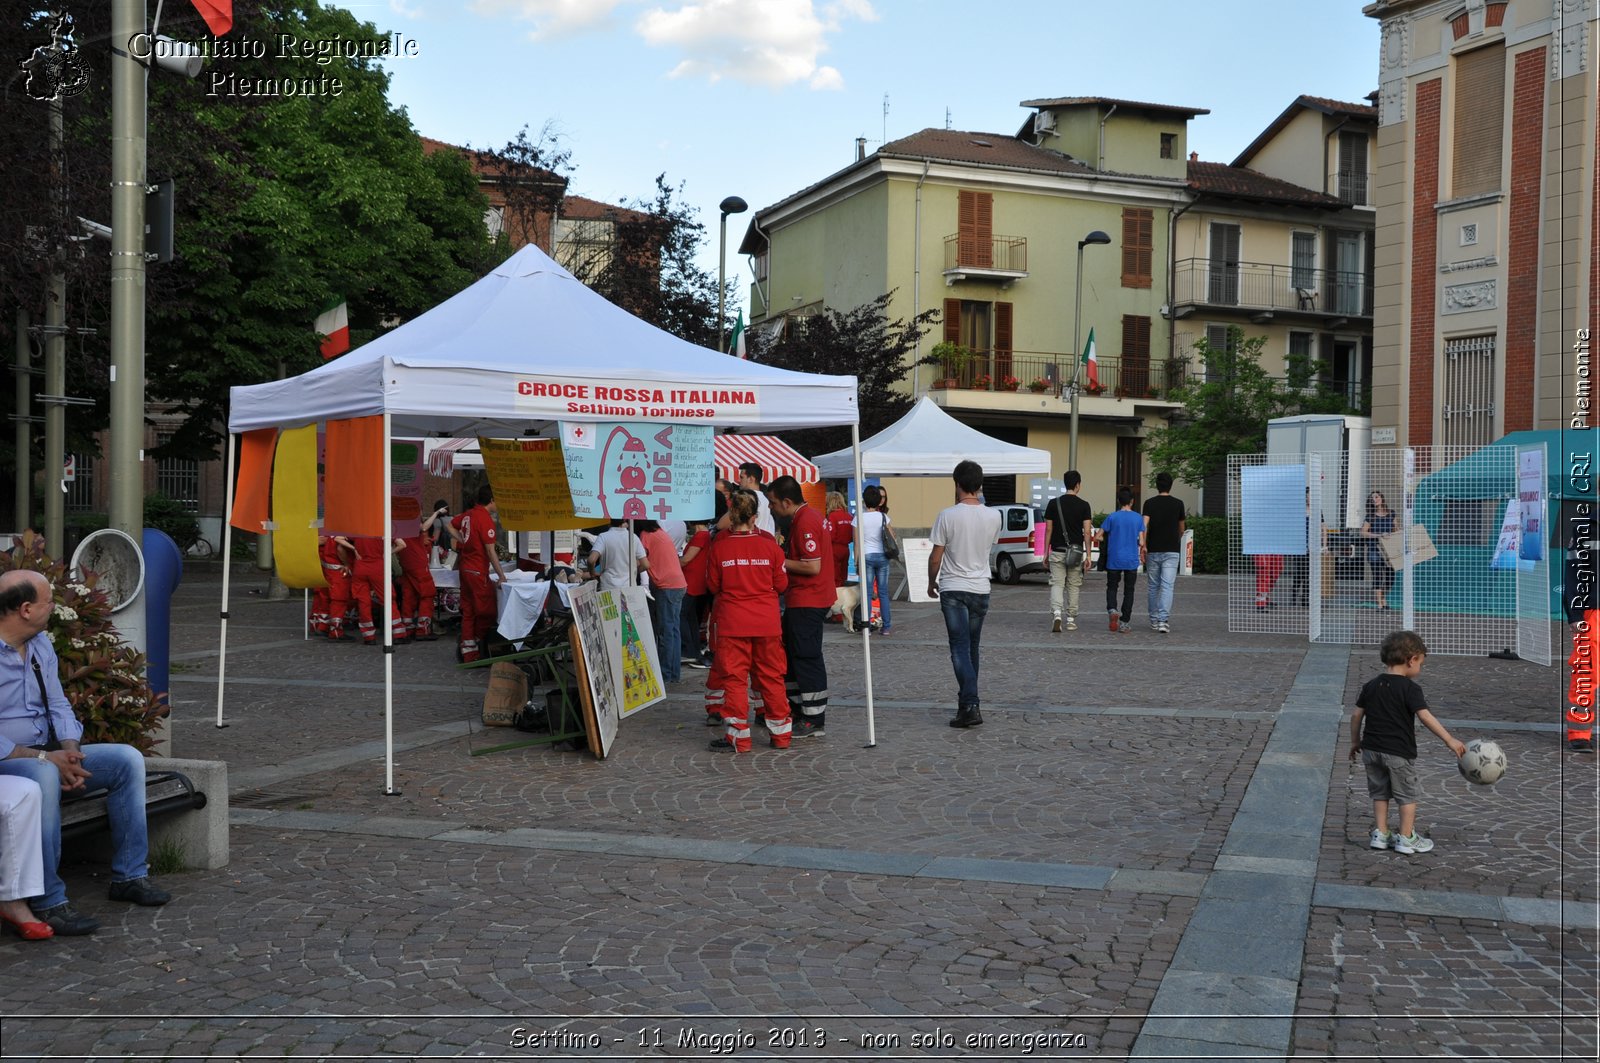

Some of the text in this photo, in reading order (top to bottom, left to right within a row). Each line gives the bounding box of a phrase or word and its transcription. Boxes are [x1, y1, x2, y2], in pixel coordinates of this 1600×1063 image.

[518, 381, 756, 404] CROCE ROSSA ITALIANA
[567, 402, 715, 418] Settimo Torinese
[652, 425, 673, 493] IDEA
